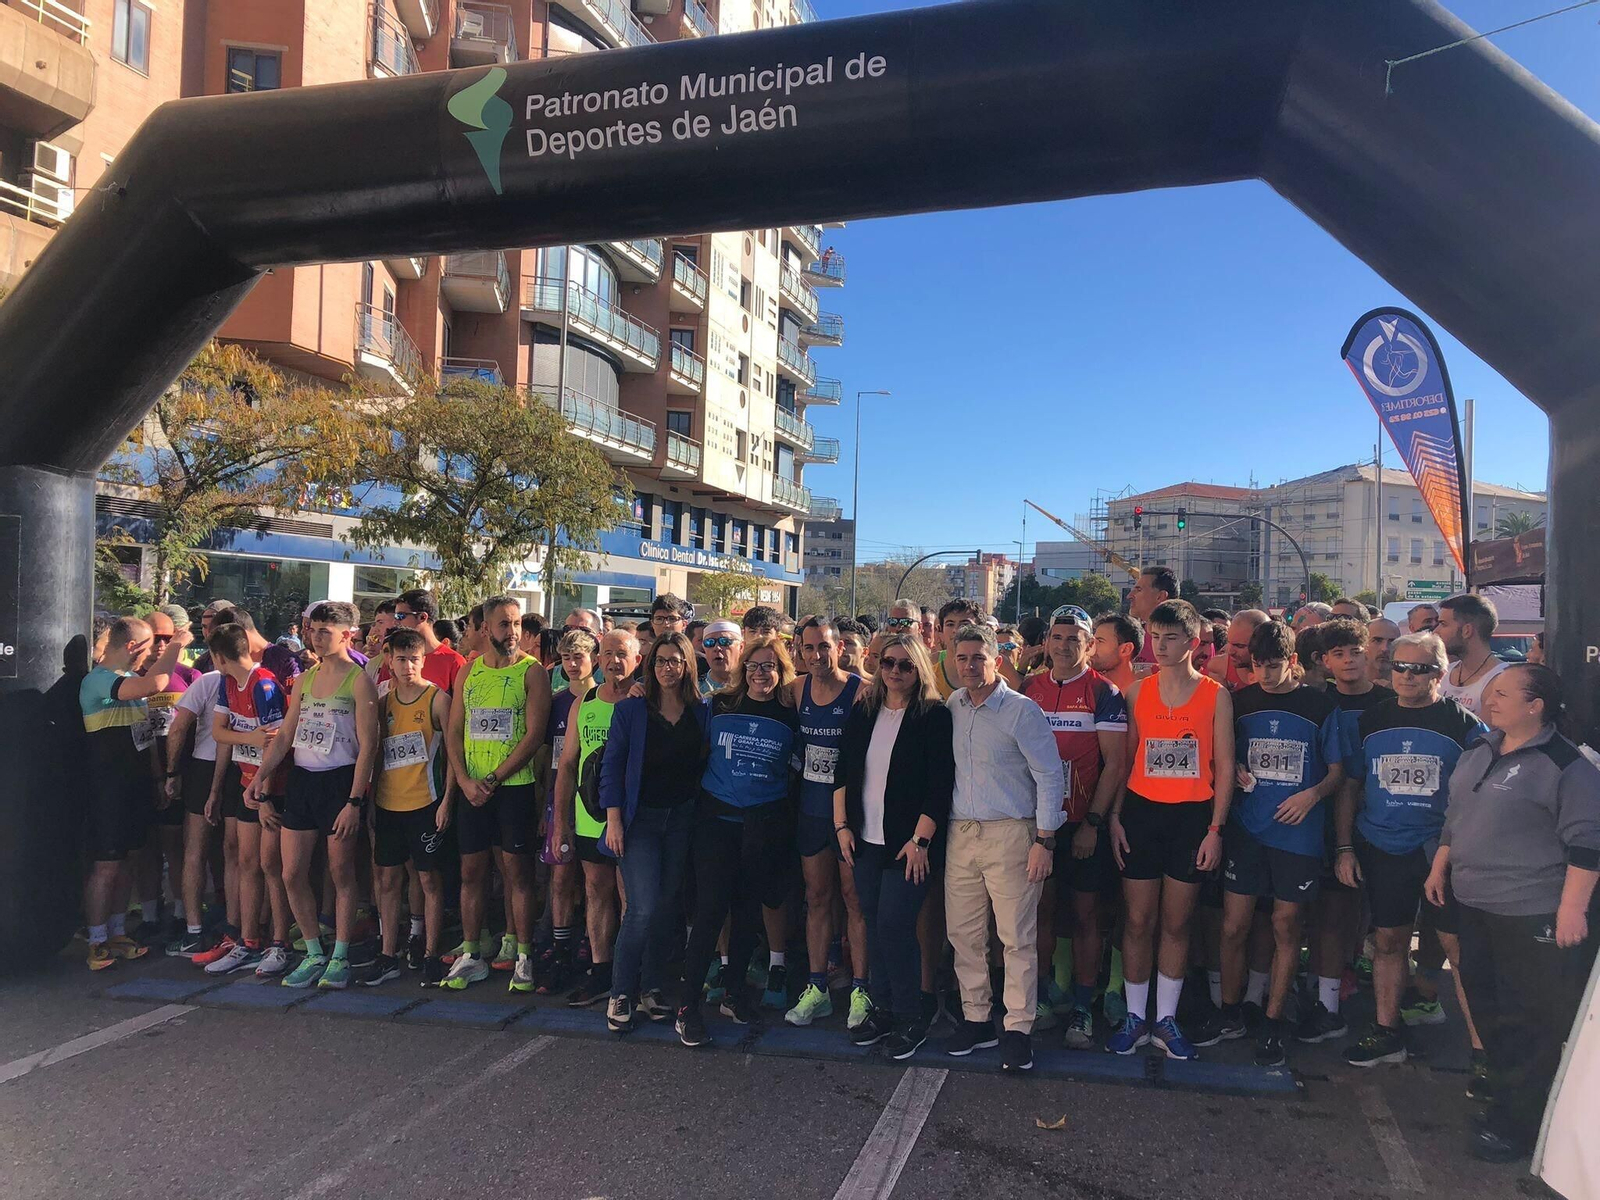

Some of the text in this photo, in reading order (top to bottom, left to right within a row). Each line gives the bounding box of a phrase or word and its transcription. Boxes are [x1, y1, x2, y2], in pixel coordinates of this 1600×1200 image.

[526, 51, 888, 120] Patronato Municipal de
[526, 99, 798, 160] Deportes de Jaén
[641, 541, 669, 561] Clínica
[672, 547, 696, 564] Dental
[698, 551, 708, 567] Dr.
[480, 718, 499, 732] 92
[300, 728, 324, 745] 319
[734, 733, 759, 742] CARRERA
[240, 744, 257, 758] 315
[391, 744, 418, 760] 184
[1153, 753, 1189, 769] 494
[1260, 753, 1289, 771] 811
[1391, 767, 1426, 785] 218
